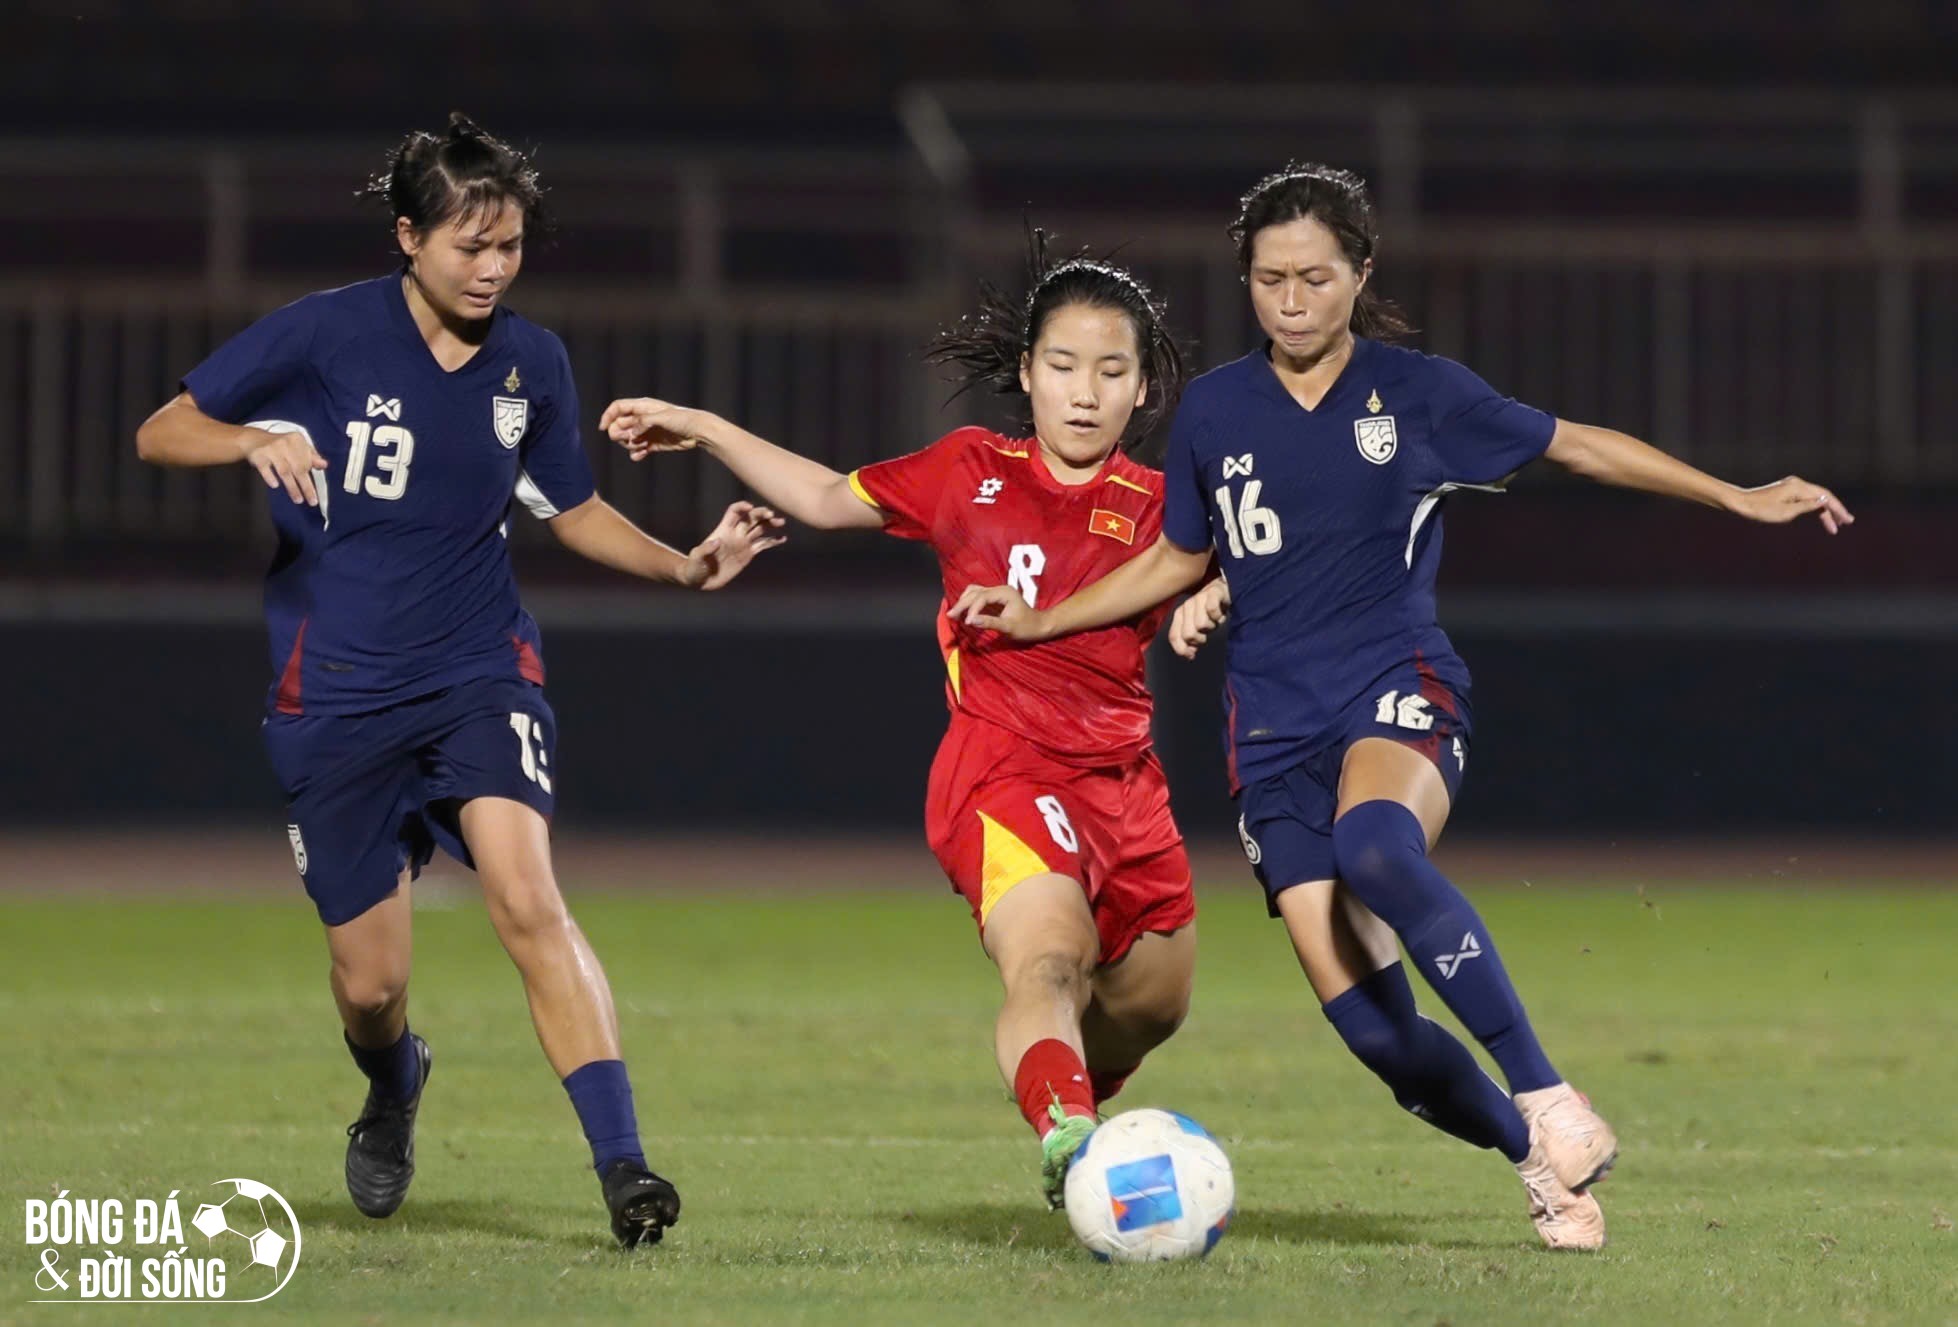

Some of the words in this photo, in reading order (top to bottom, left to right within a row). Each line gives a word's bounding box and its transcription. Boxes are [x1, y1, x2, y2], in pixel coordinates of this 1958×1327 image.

[343, 421, 415, 500] 13
[1215, 480, 1283, 559] 16
[1034, 794, 1079, 853] 8
